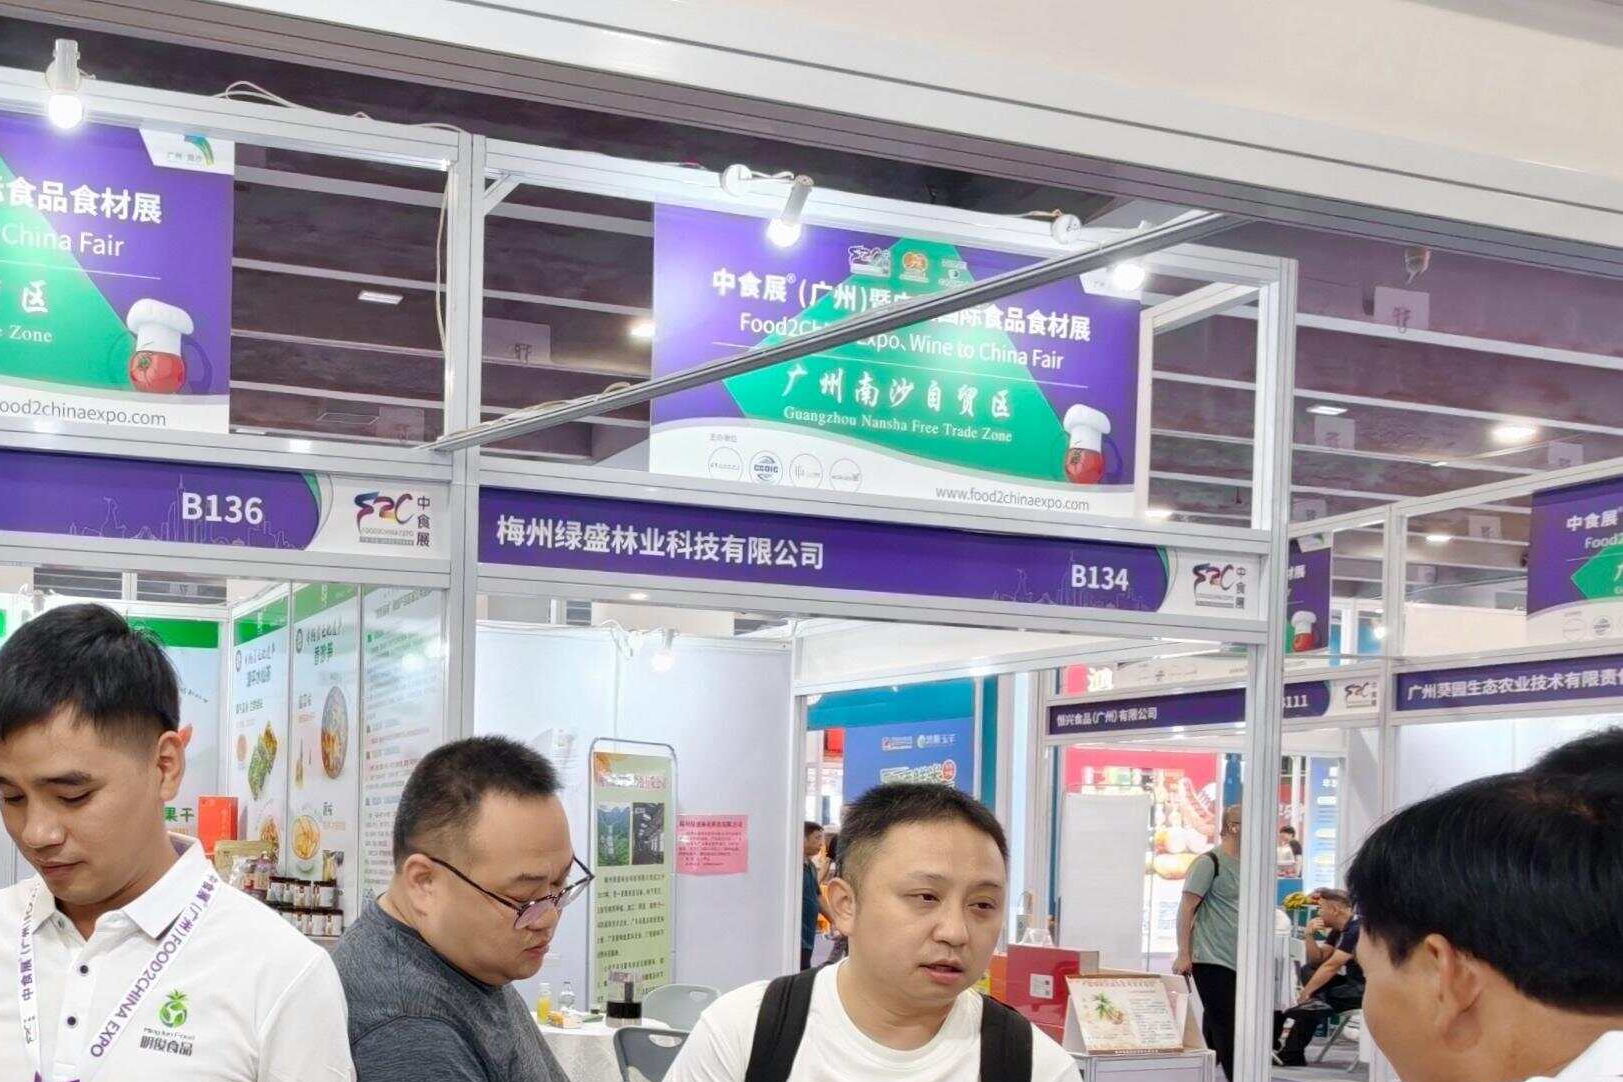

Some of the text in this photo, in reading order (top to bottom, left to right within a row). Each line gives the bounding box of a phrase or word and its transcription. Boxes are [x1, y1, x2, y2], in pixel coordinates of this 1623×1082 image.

[2, 223, 72, 250] China
[80, 232, 125, 257] Fair
[9, 324, 53, 344] Zone
[909, 334, 953, 356] Wine
[956, 341, 976, 360] to
[979, 342, 1028, 366] China
[1032, 349, 1065, 370] Fair
[782, 364, 1012, 419] 广州南沙自贸区
[783, 406, 1013, 443] Guangzhou Nansha Free Trade Zone
[182, 492, 263, 526] B136
[935, 485, 1090, 512] www.food2chinaexpo.com
[417, 495, 431, 548] 中食展
[496, 515, 824, 571] 梅州绿盛林业科技有限公司
[1071, 564, 1129, 592] B134
[90, 1019, 121, 1058] EXPO
